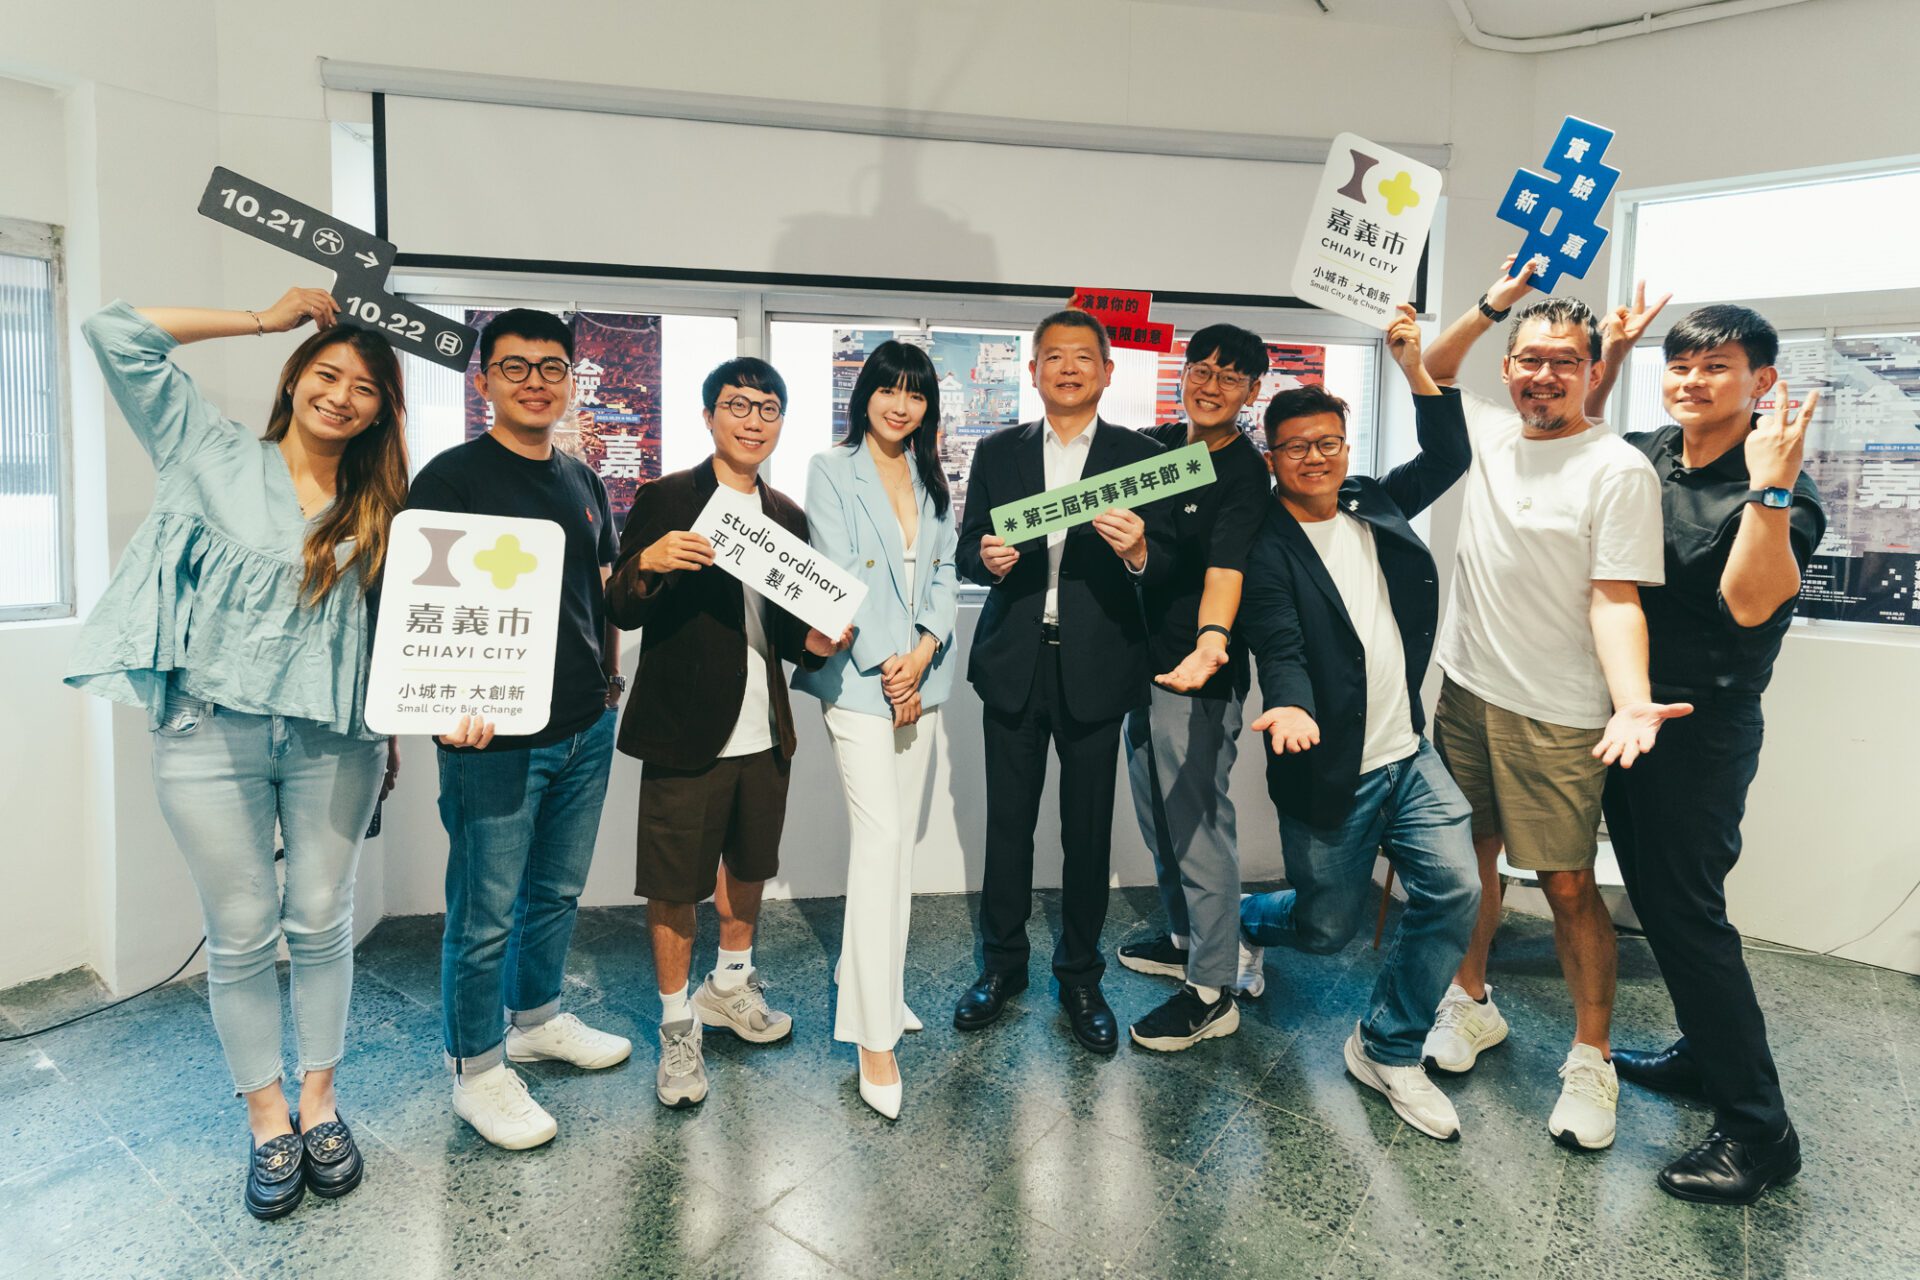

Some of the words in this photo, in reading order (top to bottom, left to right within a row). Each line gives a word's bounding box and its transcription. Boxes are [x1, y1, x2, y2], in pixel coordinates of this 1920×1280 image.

[1564, 137, 1591, 163] 實
[1515, 189, 1539, 214] 新
[1569, 174, 1596, 201] 驗
[220, 187, 306, 240] 10.21
[315, 228, 342, 252] 六
[1326, 207, 1408, 256] 嘉義市
[1322, 237, 1365, 261] CHIAYI
[1369, 257, 1397, 273] CITY
[1560, 233, 1587, 259] 嘉
[1310, 280, 1329, 292] Small
[1331, 288, 1345, 299] City
[1348, 294, 1358, 305] Big
[1360, 298, 1387, 314] Change
[1312, 266, 1348, 287] 小城市
[1355, 283, 1390, 305] 大創新
[1082, 294, 1140, 313] 演算你的
[346, 295, 427, 342] 10.22
[437, 332, 461, 354] 日
[1022, 463, 1180, 529] 第三屆有事青年節
[722, 512, 775, 553] studio
[779, 551, 847, 602] ordinary
[765, 568, 803, 601] 製作
[406, 603, 532, 637] 嘉義市
[403, 645, 473, 658] CHIAYI
[483, 648, 527, 660] CITY
[399, 683, 457, 699] 小城市
[470, 685, 525, 700] 大創新
[397, 704, 428, 712] Small
[433, 704, 456, 715] City
[461, 705, 477, 716] Big
[482, 705, 523, 716] Change
